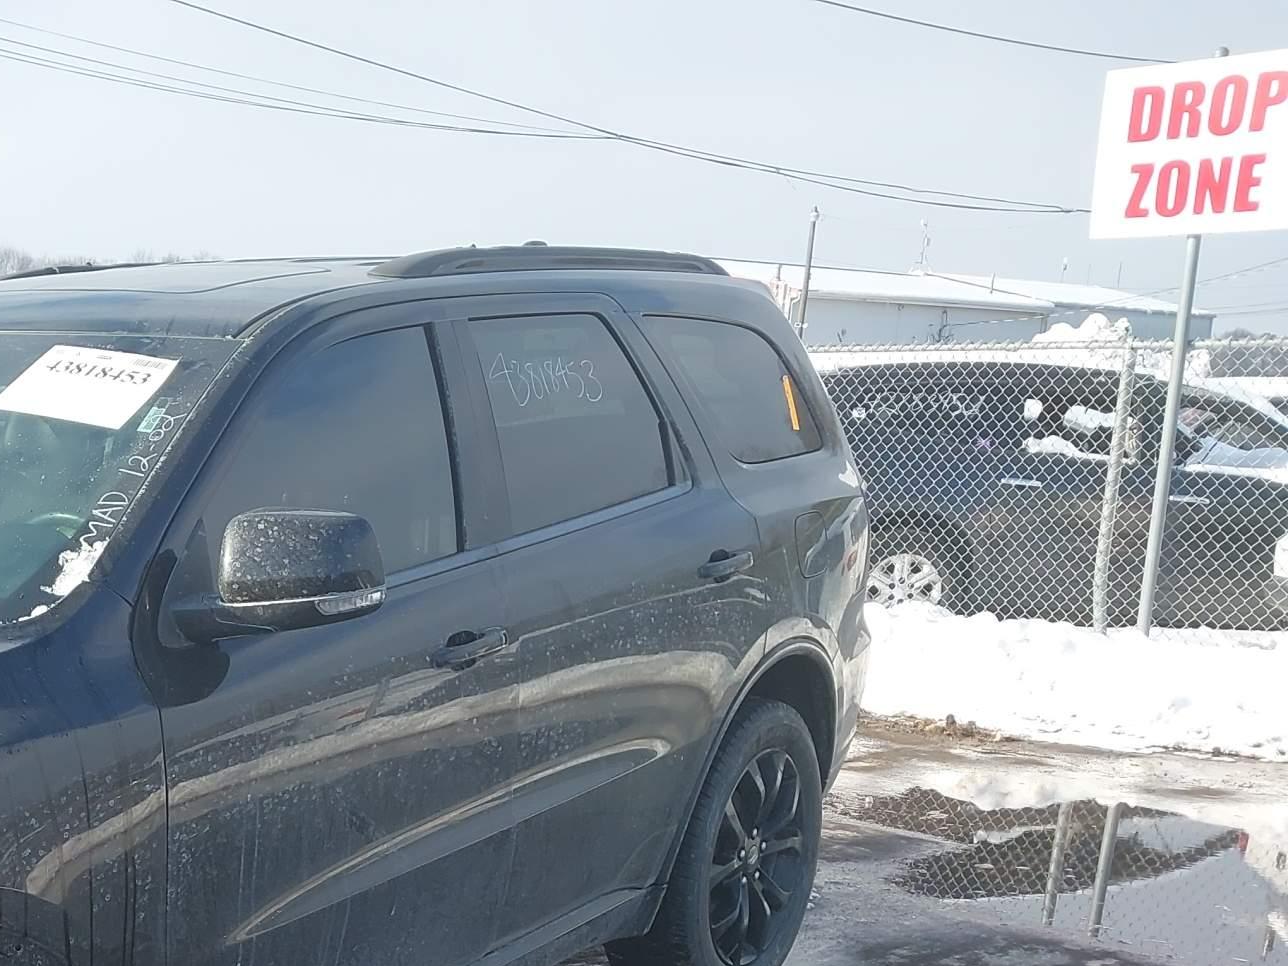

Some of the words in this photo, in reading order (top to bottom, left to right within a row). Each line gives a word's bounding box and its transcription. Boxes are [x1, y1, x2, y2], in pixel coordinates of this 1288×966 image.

[1127, 70, 1288, 143] DROP
[1124, 153, 1267, 219] ZONE
[46, 360, 152, 385] 43818453
